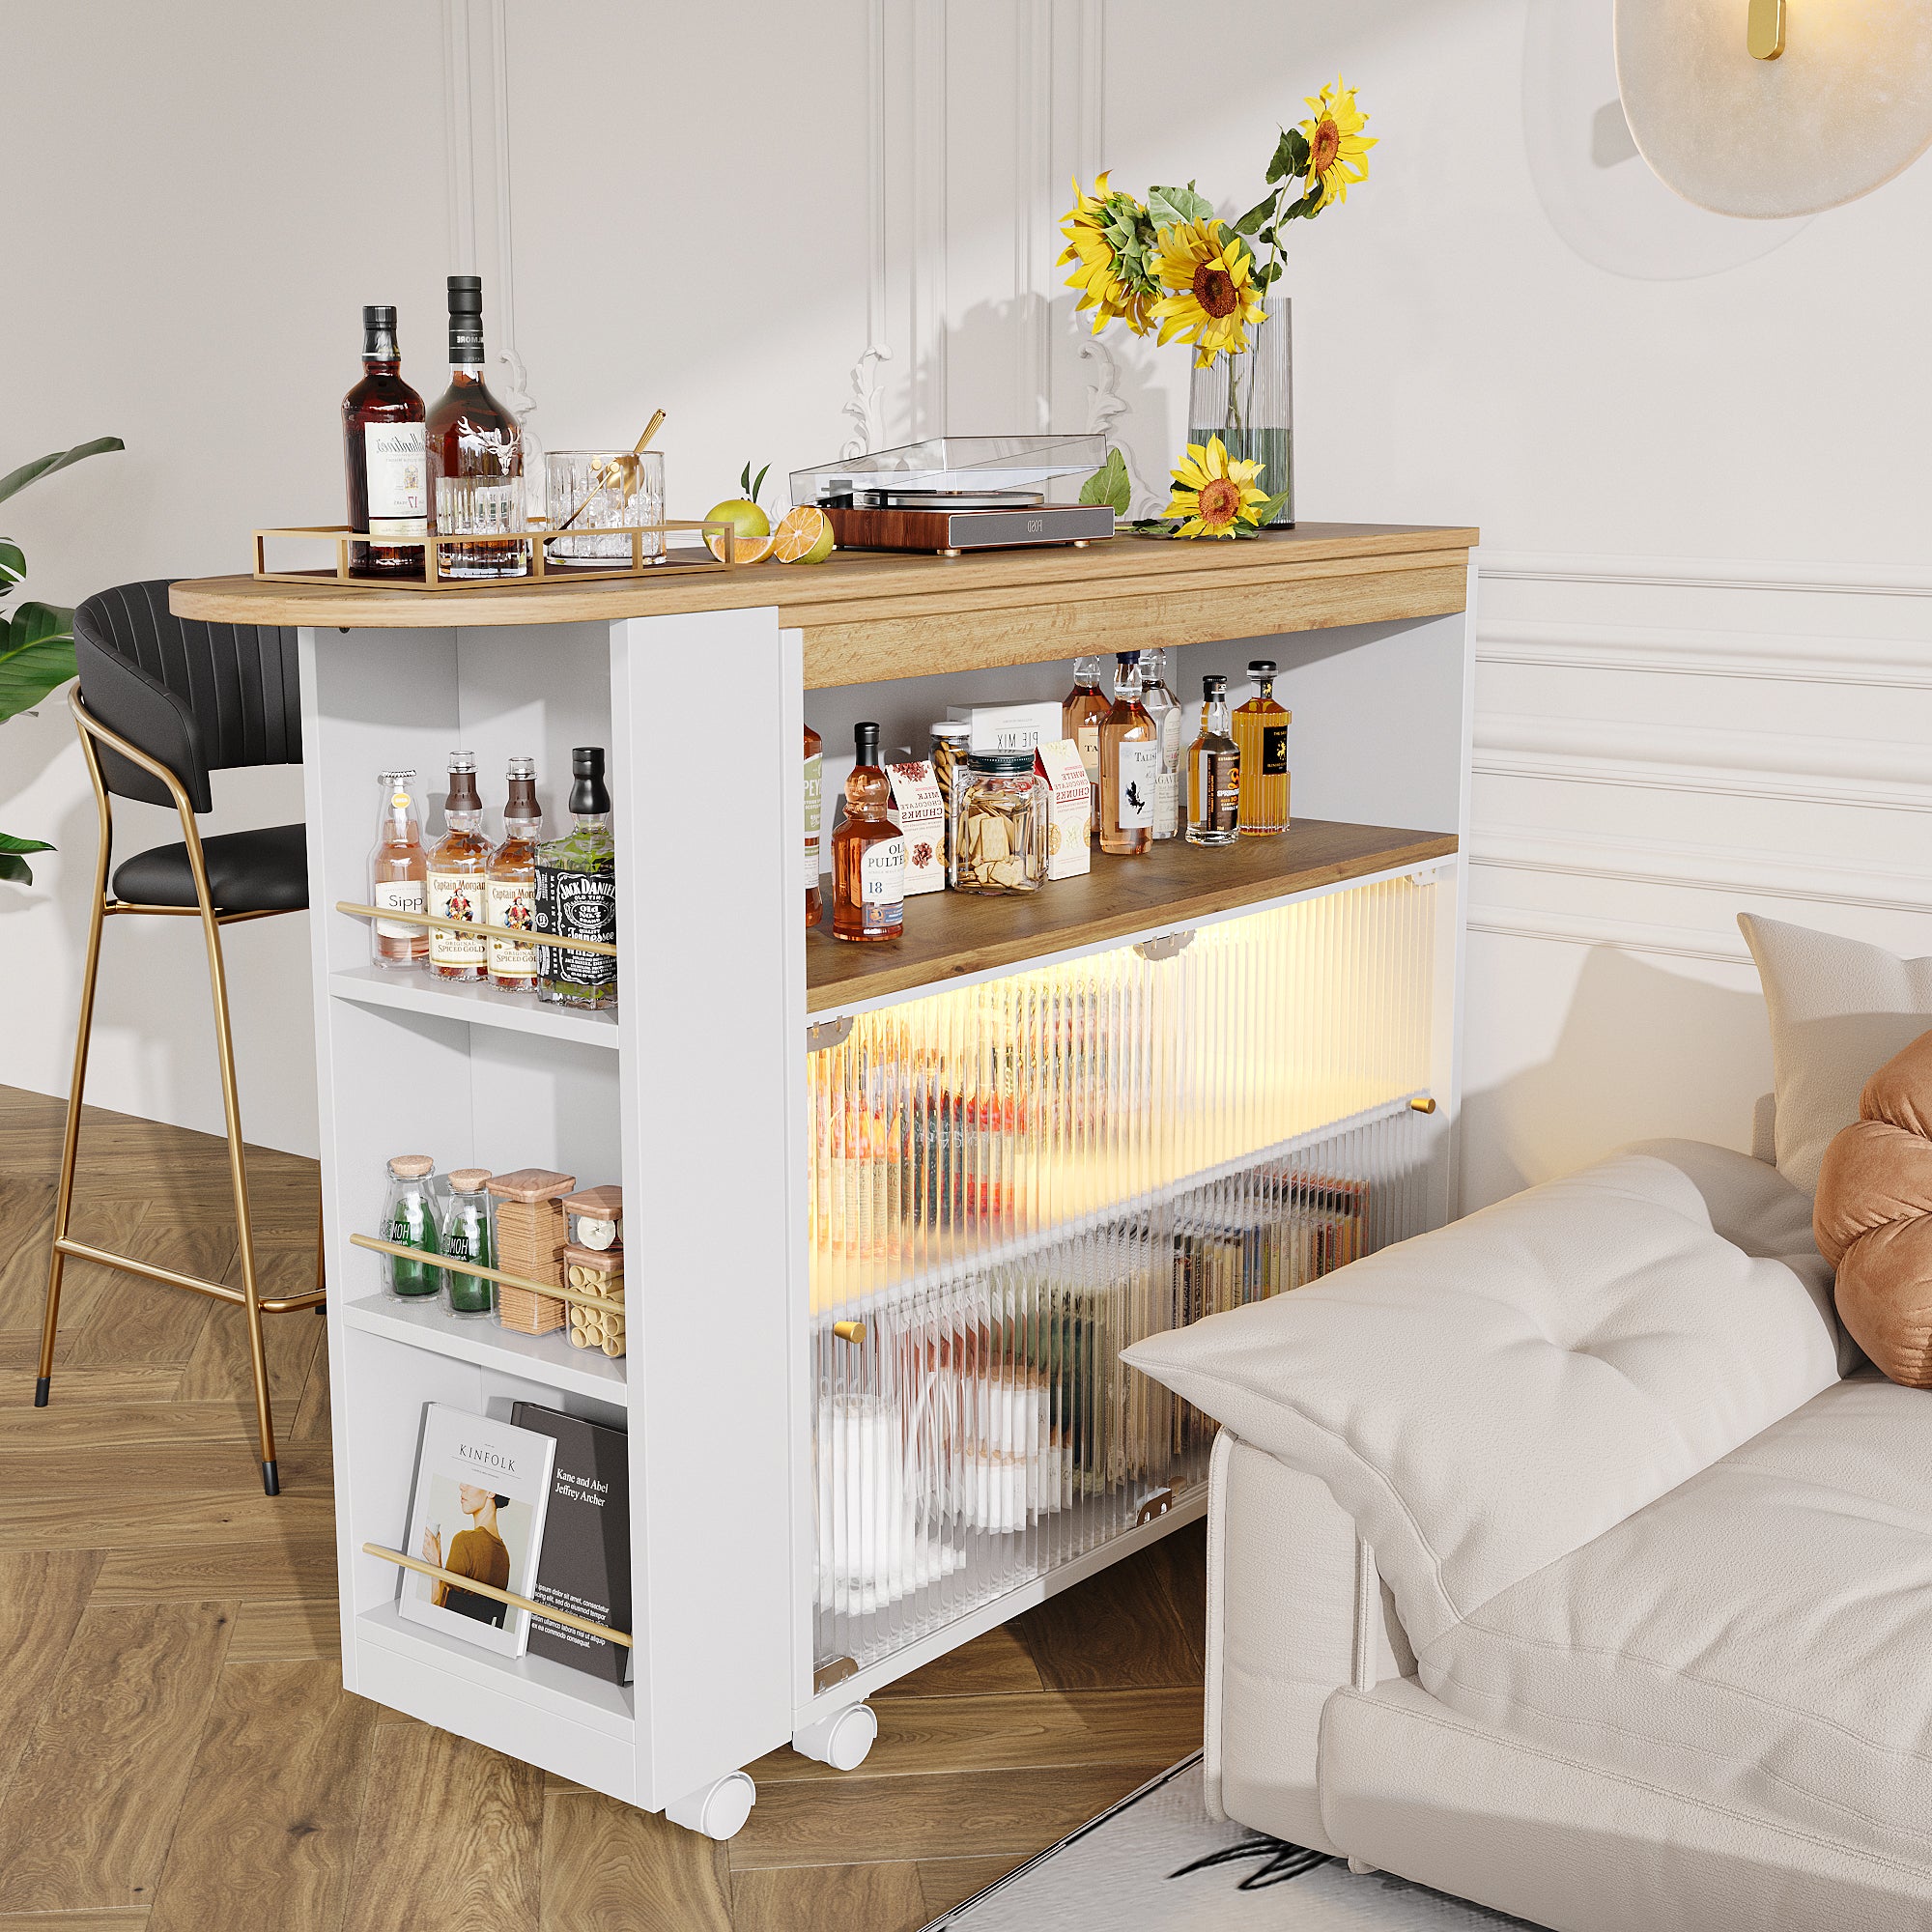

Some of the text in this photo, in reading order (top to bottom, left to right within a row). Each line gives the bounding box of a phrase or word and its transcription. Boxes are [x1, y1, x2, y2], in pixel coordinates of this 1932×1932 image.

[433, 879, 485, 892] Captain Morgan
[492, 888, 516, 900] Captain
[560, 882, 582, 900] JACK
[869, 881, 883, 895] 18
[388, 895, 423, 911] Sipp
[459, 1444, 515, 1472] KINFOLK
[556, 1467, 609, 1493] Kane and Abel
[554, 1482, 606, 1507] Jeffrey Archer
